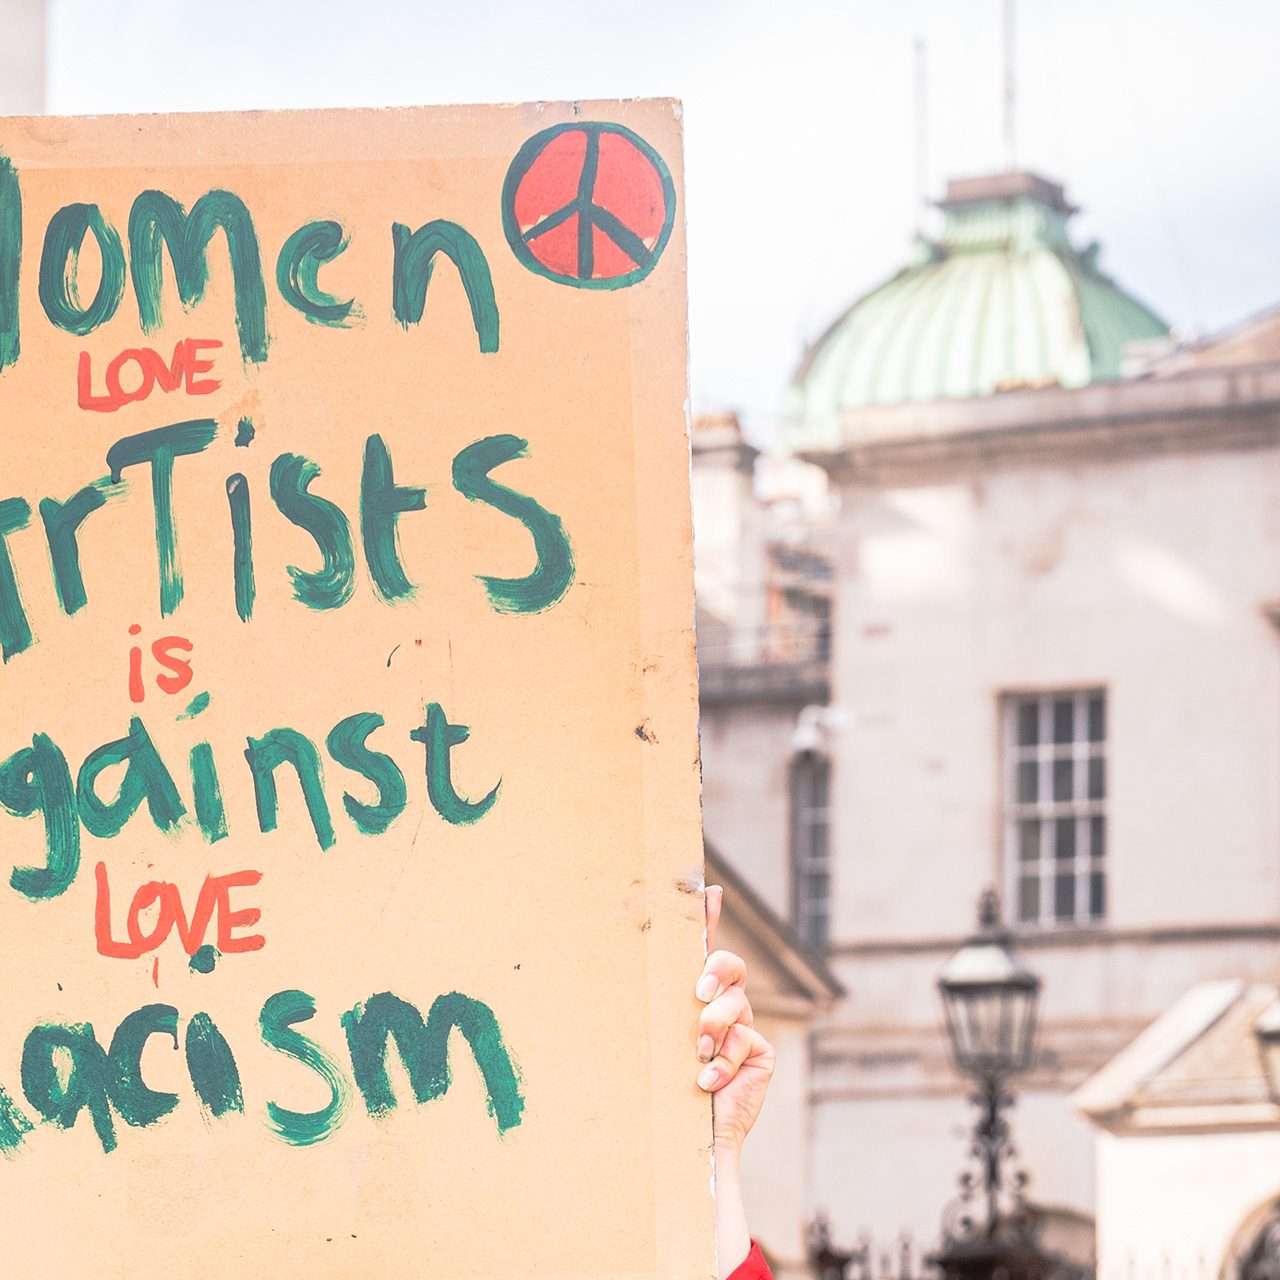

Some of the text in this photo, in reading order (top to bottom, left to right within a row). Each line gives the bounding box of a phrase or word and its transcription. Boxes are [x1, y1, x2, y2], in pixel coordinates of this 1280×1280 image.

[77, 338, 223, 413] LOVE
[127, 624, 194, 703] is
[95, 862, 266, 961] LOVE
